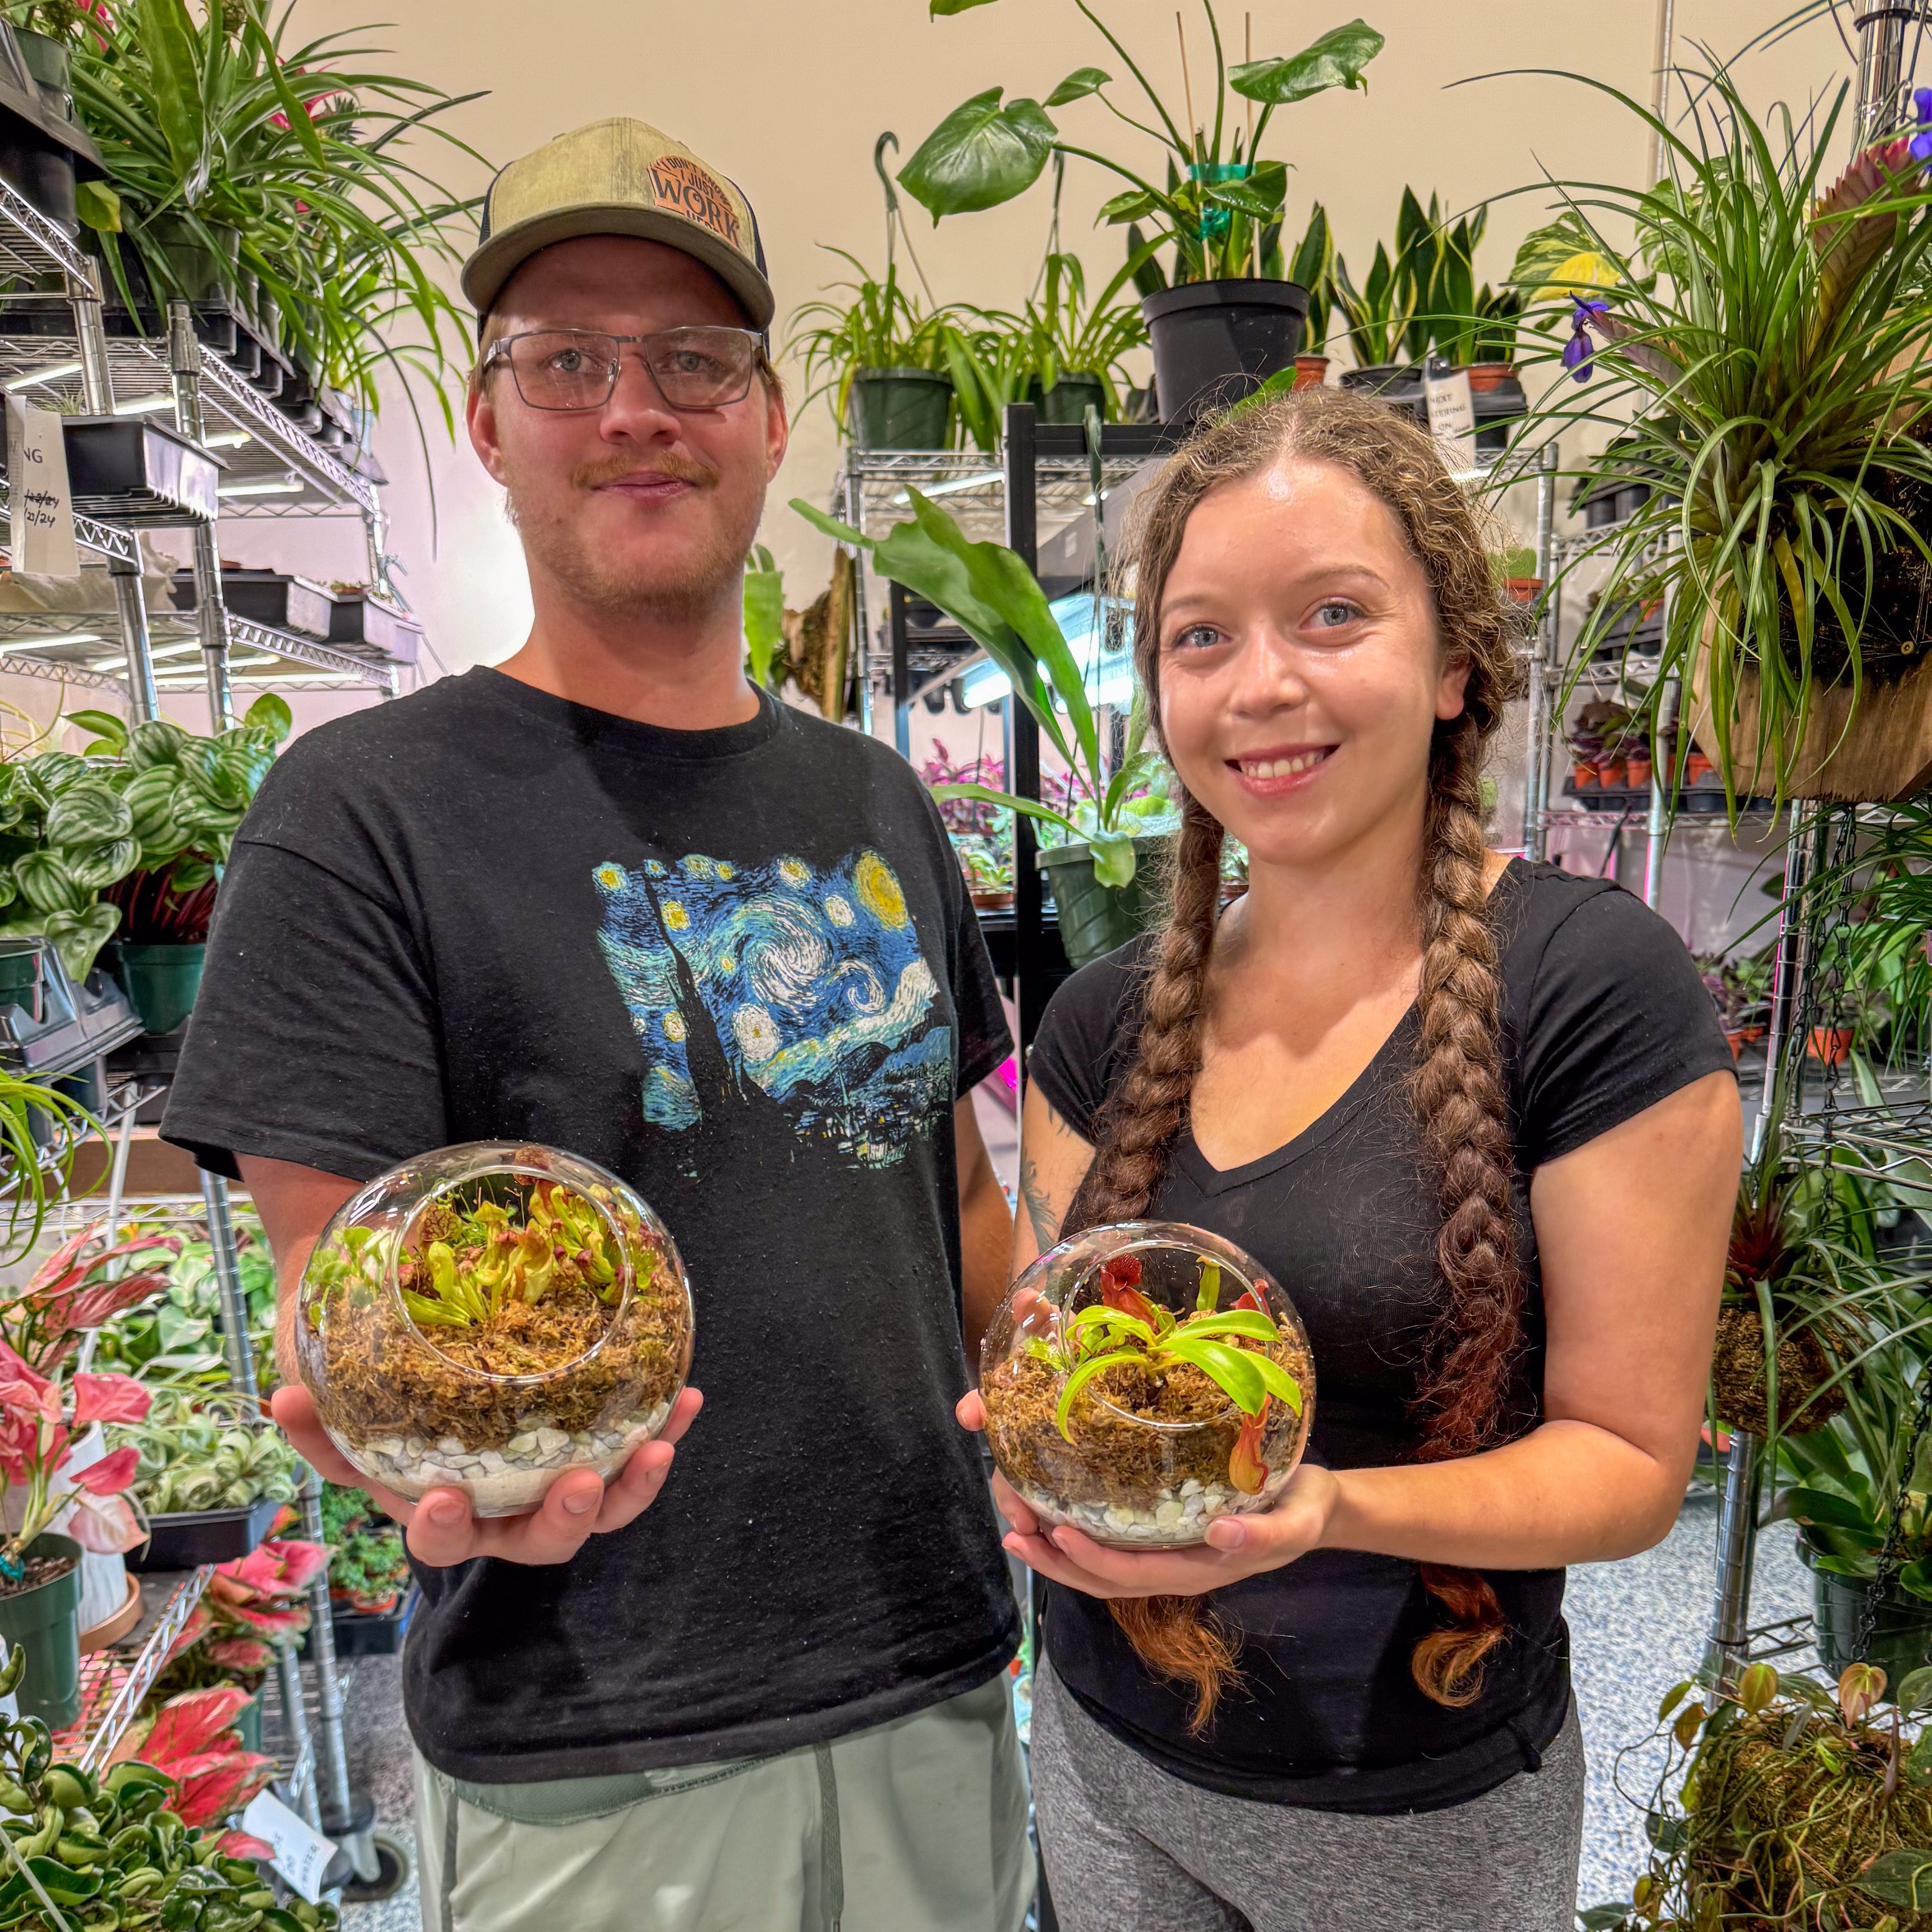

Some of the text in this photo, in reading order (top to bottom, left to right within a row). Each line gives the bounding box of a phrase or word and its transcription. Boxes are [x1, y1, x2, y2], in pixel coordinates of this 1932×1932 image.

[667, 157, 697, 173] DON'T
[681, 170, 714, 199] I JUST
[652, 168, 743, 252] WORK
